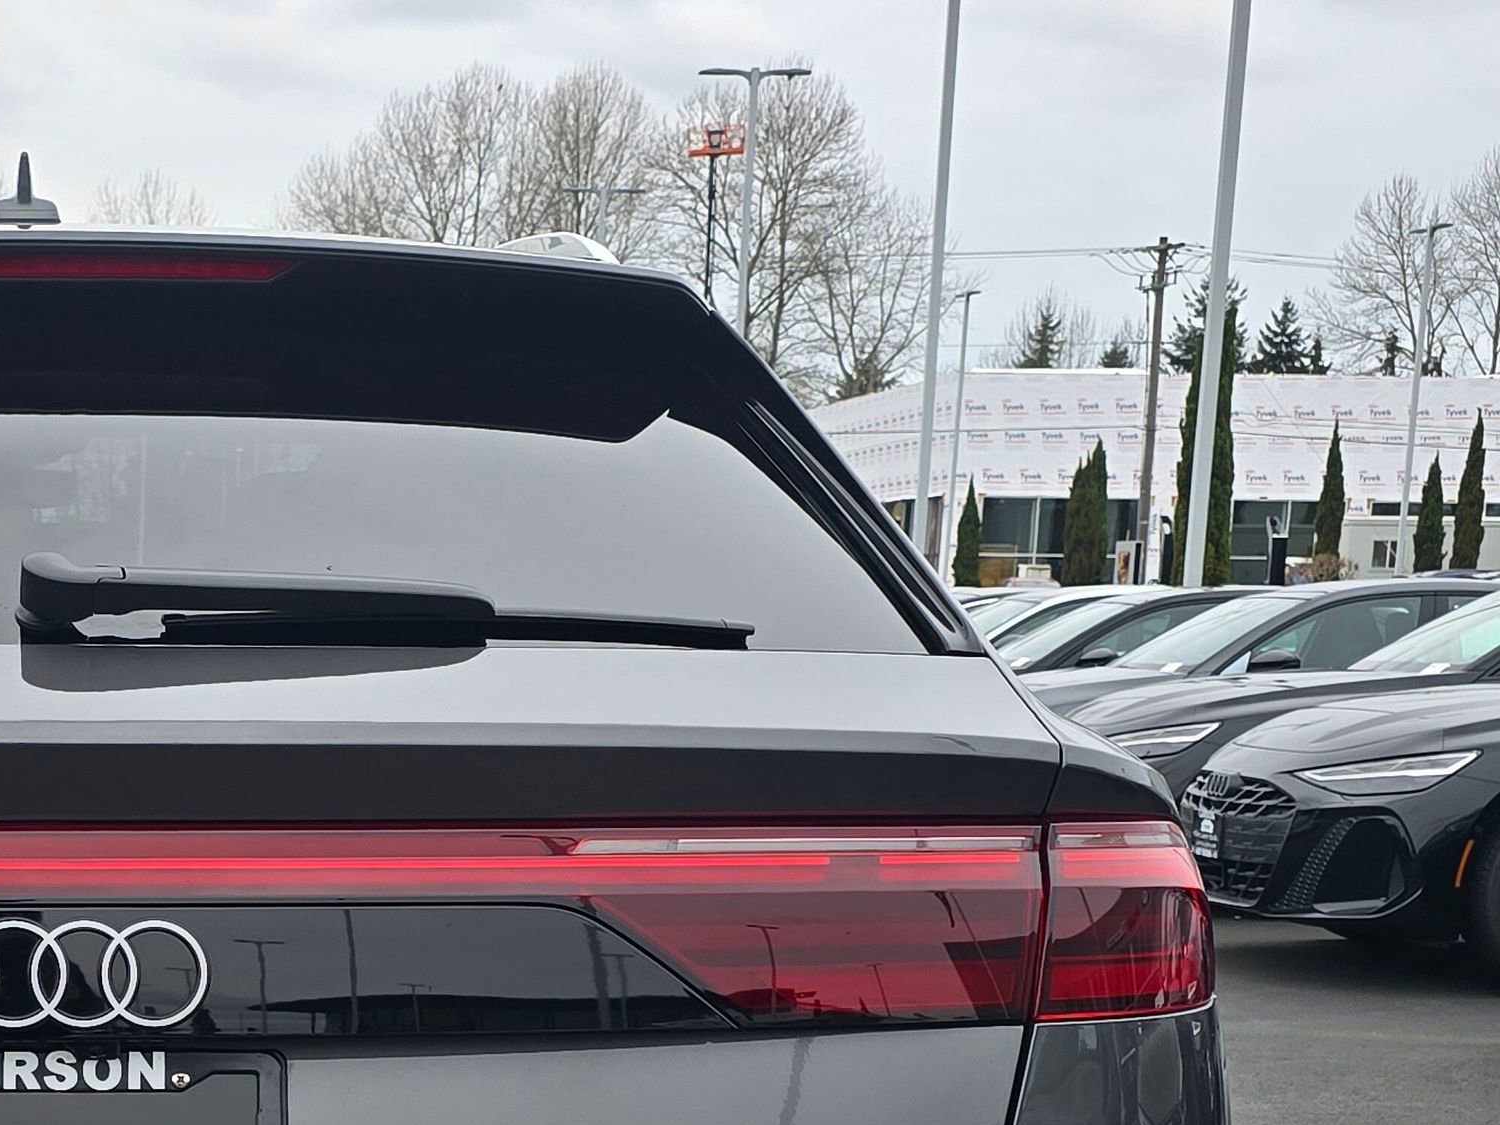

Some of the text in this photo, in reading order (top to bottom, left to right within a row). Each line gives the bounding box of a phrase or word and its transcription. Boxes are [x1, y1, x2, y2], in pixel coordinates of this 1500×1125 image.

[1294, 410, 1315, 419] Tyvek
[1370, 409, 1392, 417] Tyvek
[1446, 408, 1468, 417] Tyvek
[1246, 474, 1267, 483] Tyvek
[1284, 474, 1305, 483] Tyvek
[1360, 474, 1381, 483] Tyvek
